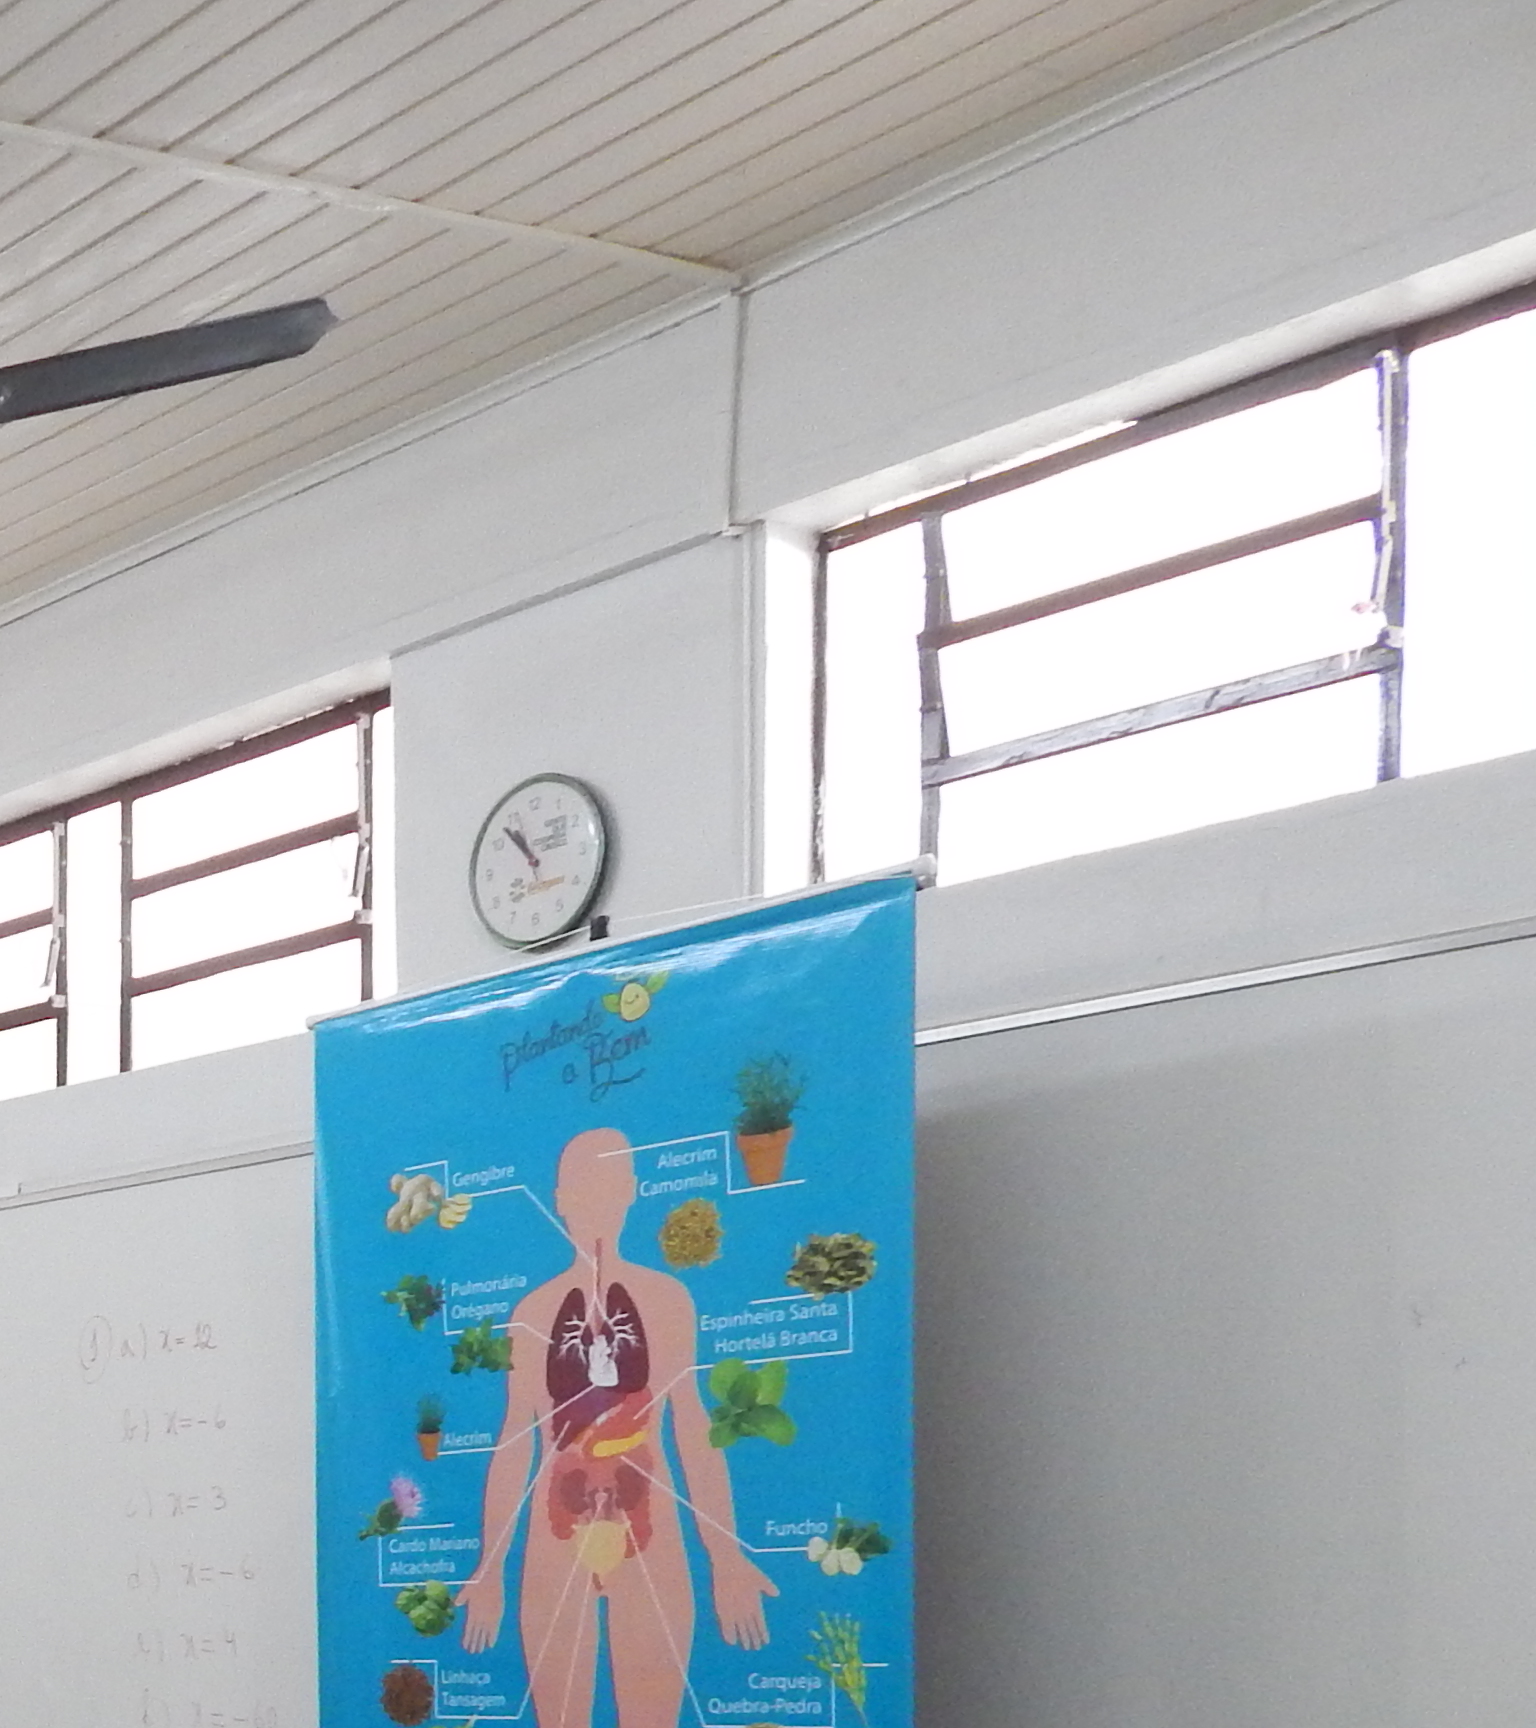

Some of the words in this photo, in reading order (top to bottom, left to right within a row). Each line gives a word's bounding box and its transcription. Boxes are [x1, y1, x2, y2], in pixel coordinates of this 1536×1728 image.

[657, 1148, 717, 1169] Alecrim
[452, 1164, 515, 1187] Gengibre
[700, 1308, 785, 1333] Espinheira
[789, 1302, 838, 1320] Santa
[780, 1329, 838, 1347] Branca
[443, 1431, 492, 1447] Alecrim
[765, 1518, 828, 1537] Funcho
[748, 1672, 822, 1693] Carqueja
[708, 1697, 822, 1714] Quebra-Pedra
